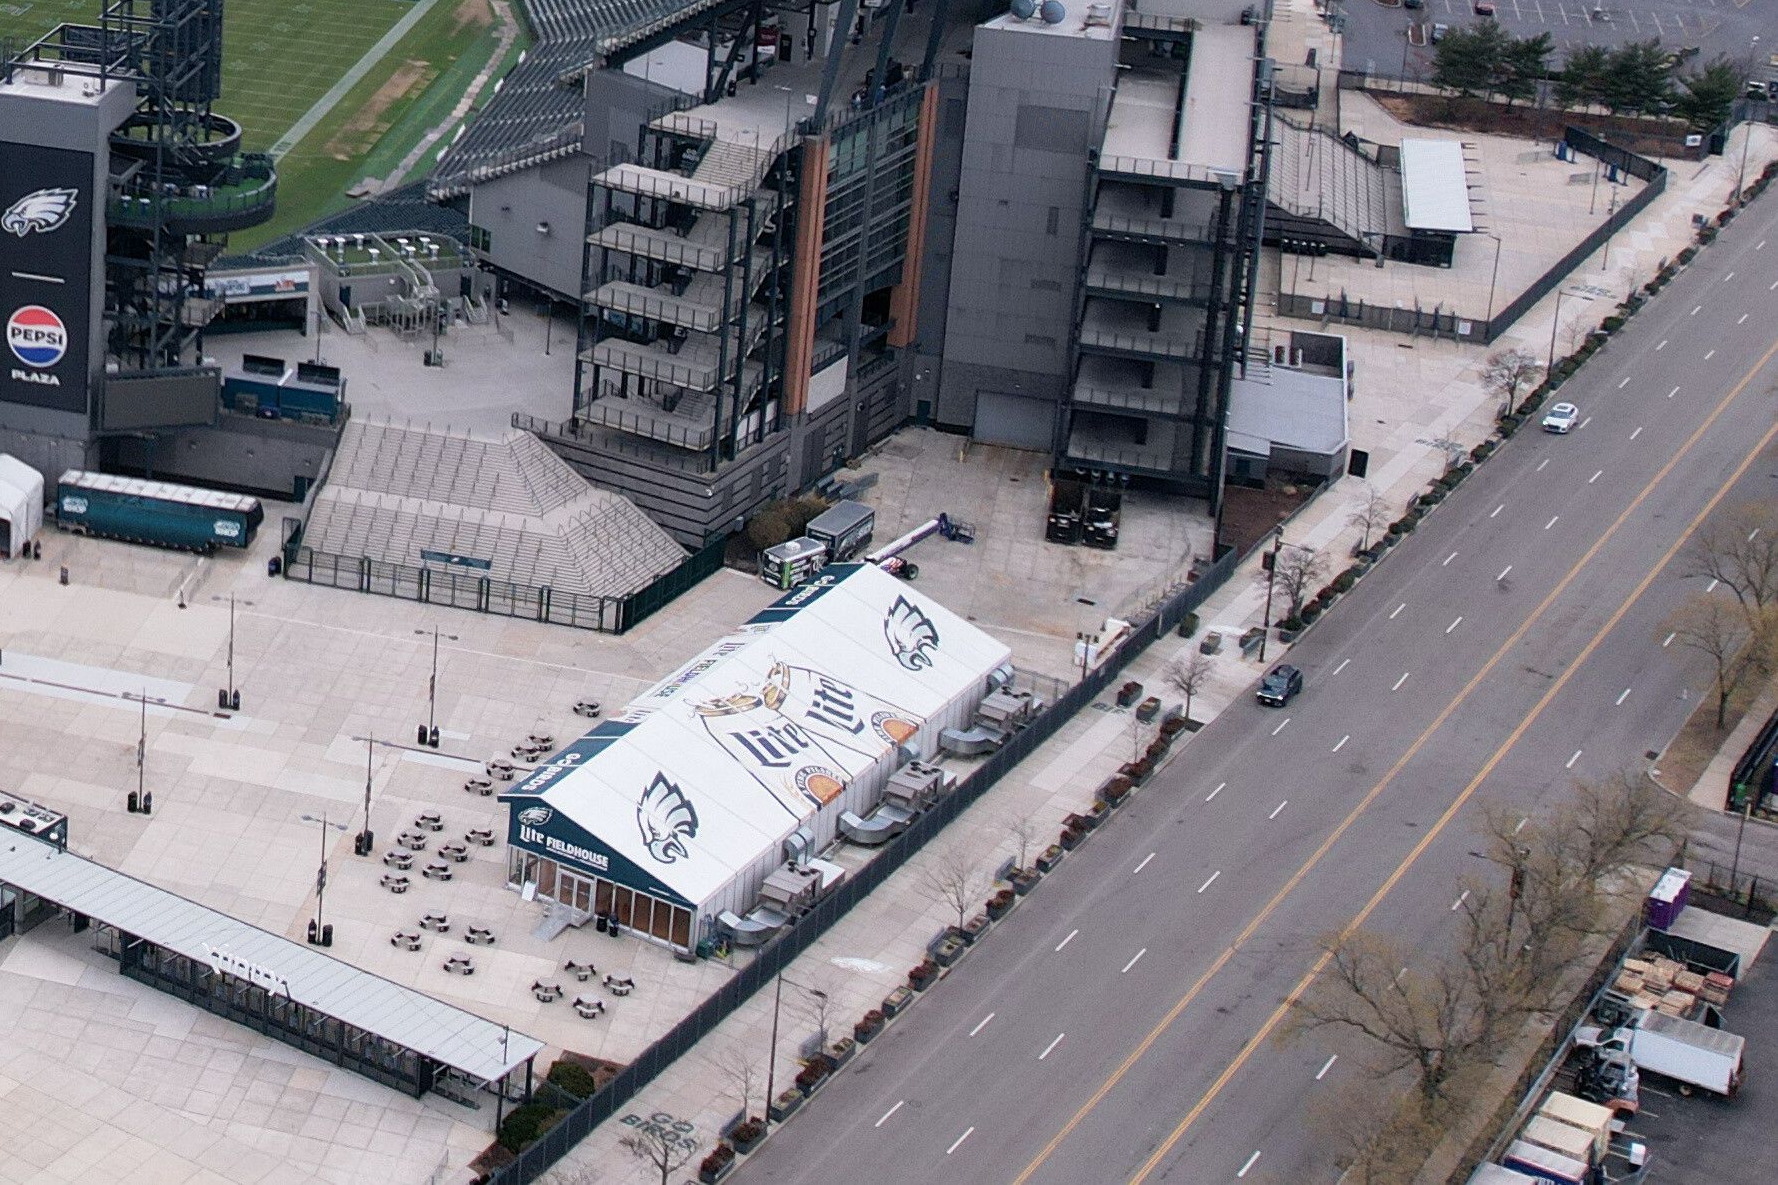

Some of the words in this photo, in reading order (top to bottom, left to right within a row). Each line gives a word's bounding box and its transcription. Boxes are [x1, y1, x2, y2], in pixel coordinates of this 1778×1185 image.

[11, 326, 64, 347] PEPSI
[11, 368, 61, 386] PLAZA
[805, 677, 866, 735] Lite
[728, 722, 810, 768] Lite
[519, 824, 545, 844] Lite
[546, 835, 610, 868] FIELDHOUSE
